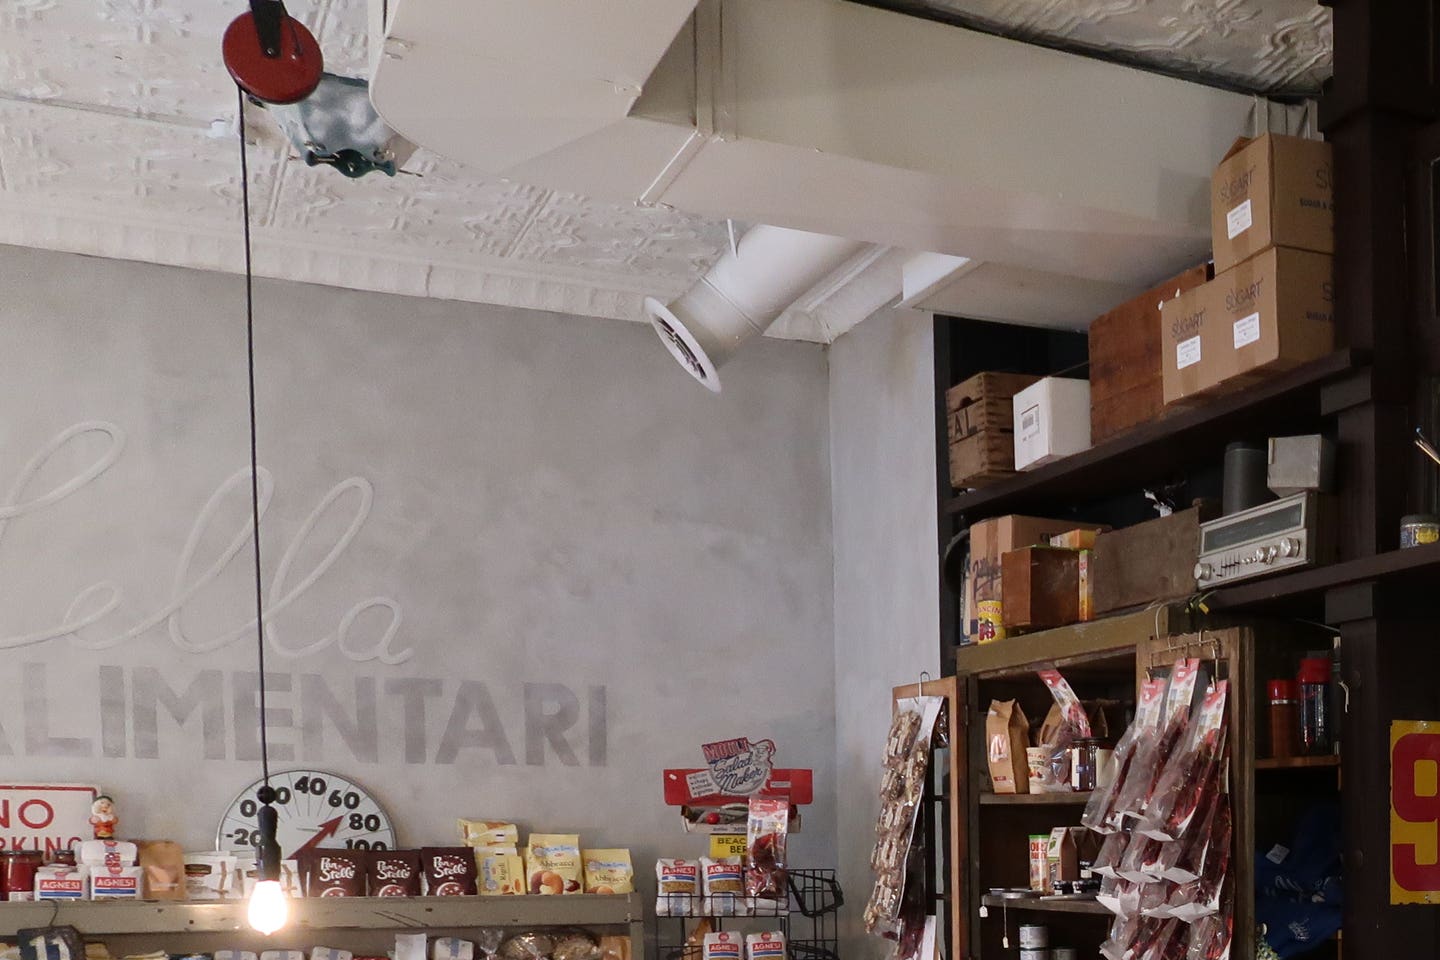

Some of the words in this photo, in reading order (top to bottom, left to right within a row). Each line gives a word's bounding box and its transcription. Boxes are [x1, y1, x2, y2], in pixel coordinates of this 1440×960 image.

[0, 660, 609, 768] LIMENTARI
[294, 775, 327, 796] 40
[239, 799, 258, 818] 0
[328, 789, 360, 810] 60
[349, 812, 381, 832] 80
[41, 881, 81, 890] AGNESI
[96, 878, 135, 888] AGNESI
[753, 942, 782, 950] AGNESI
